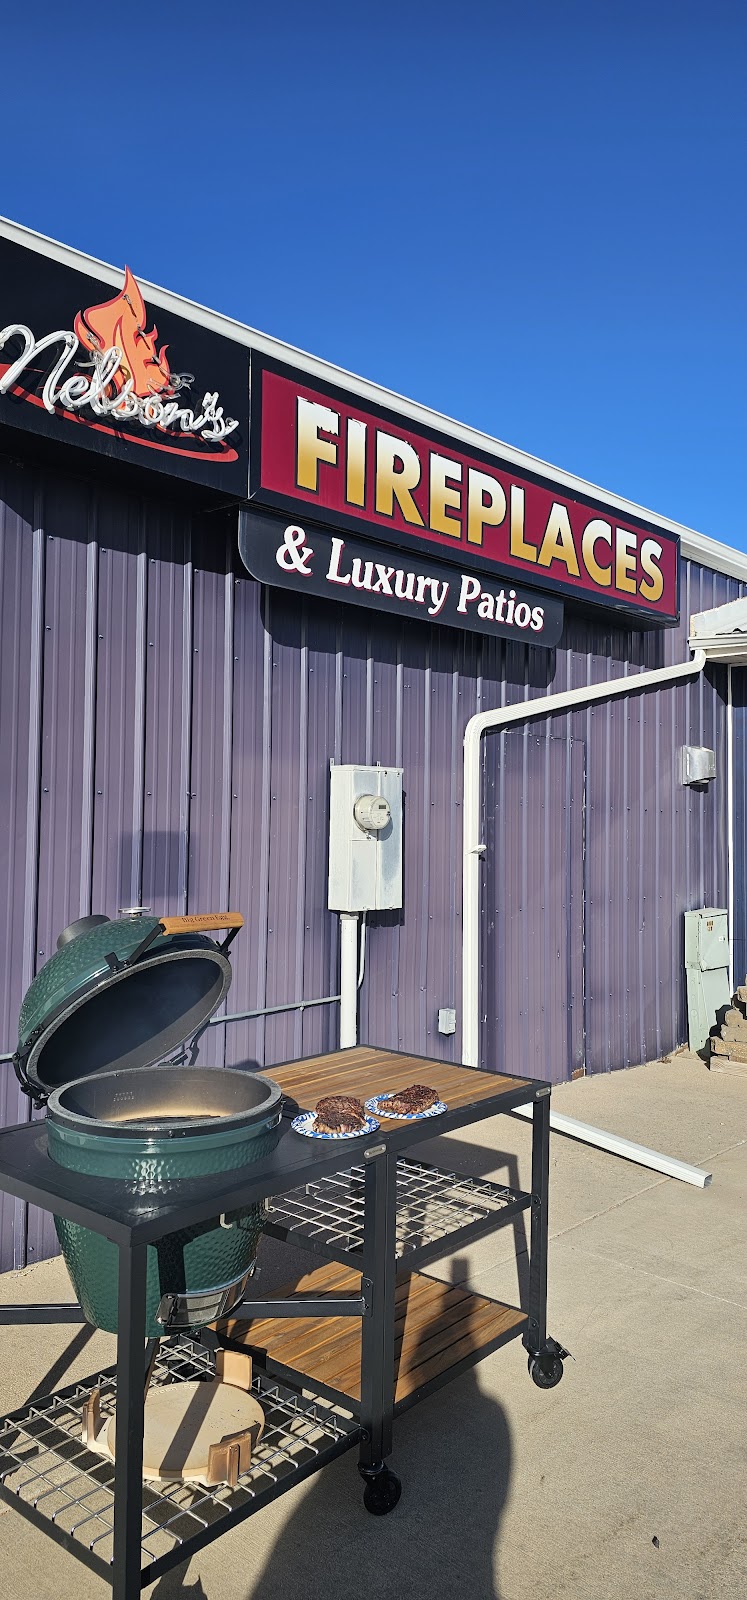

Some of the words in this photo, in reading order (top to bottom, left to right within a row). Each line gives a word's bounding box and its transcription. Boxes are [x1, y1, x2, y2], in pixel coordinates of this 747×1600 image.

[0, 324, 239, 442] Nelson's
[296, 395, 665, 602] FIREPLACES
[275, 525, 313, 575] &
[326, 537, 449, 615] Luxury
[456, 574, 545, 632] Patios
